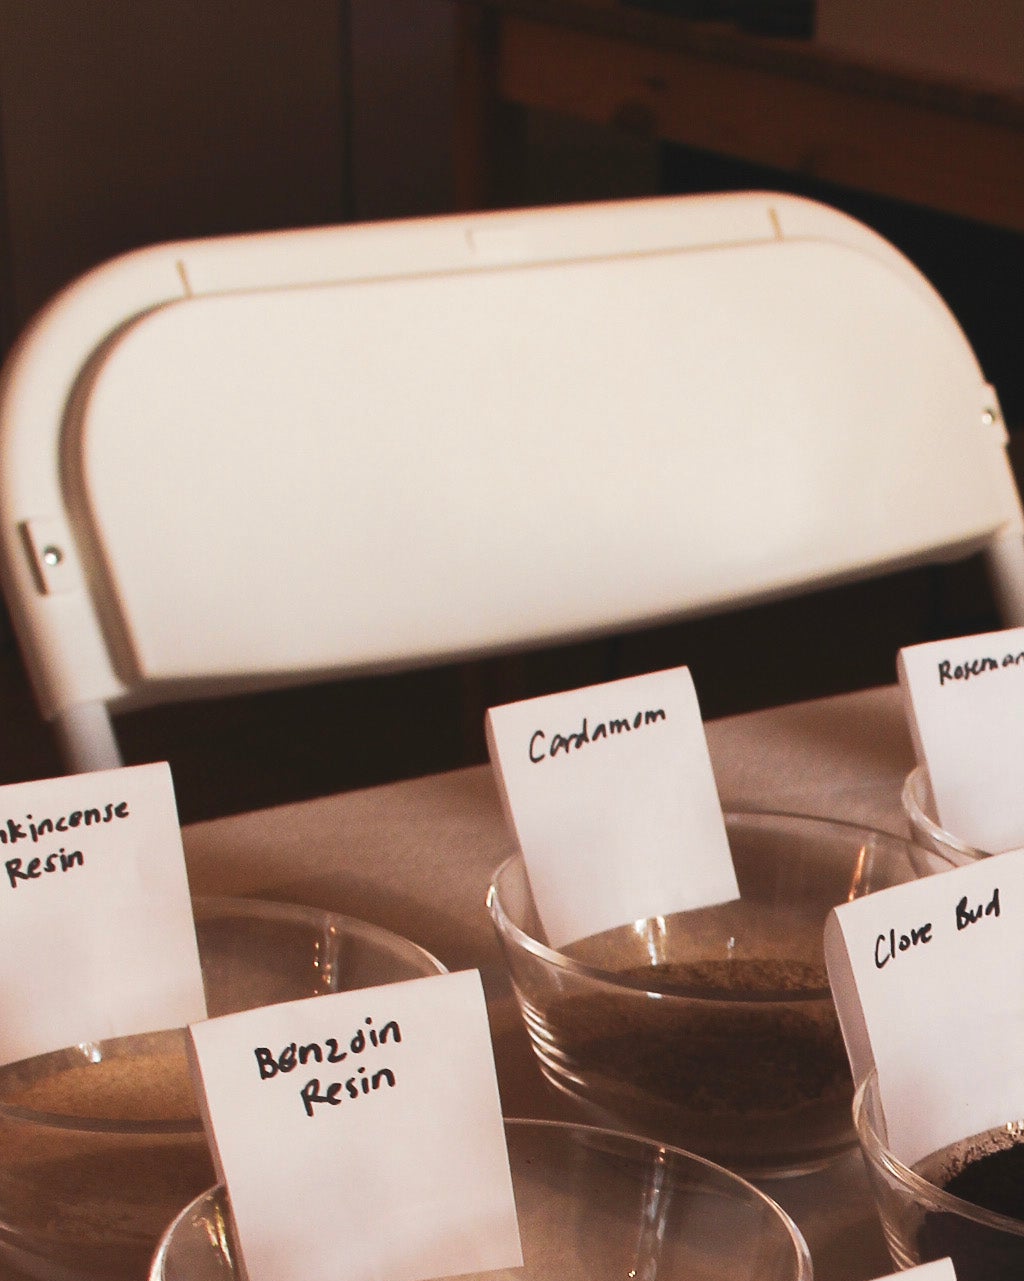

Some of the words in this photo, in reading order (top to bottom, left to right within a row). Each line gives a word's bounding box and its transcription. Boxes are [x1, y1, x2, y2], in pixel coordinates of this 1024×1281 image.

[528, 708, 668, 765] Cardamom
[4, 847, 86, 890] Resin
[873, 922, 934, 970] Clove
[954, 887, 1002, 932] Bud
[253, 1015, 403, 1081] Benzoin
[299, 1066, 398, 1118] Resin
